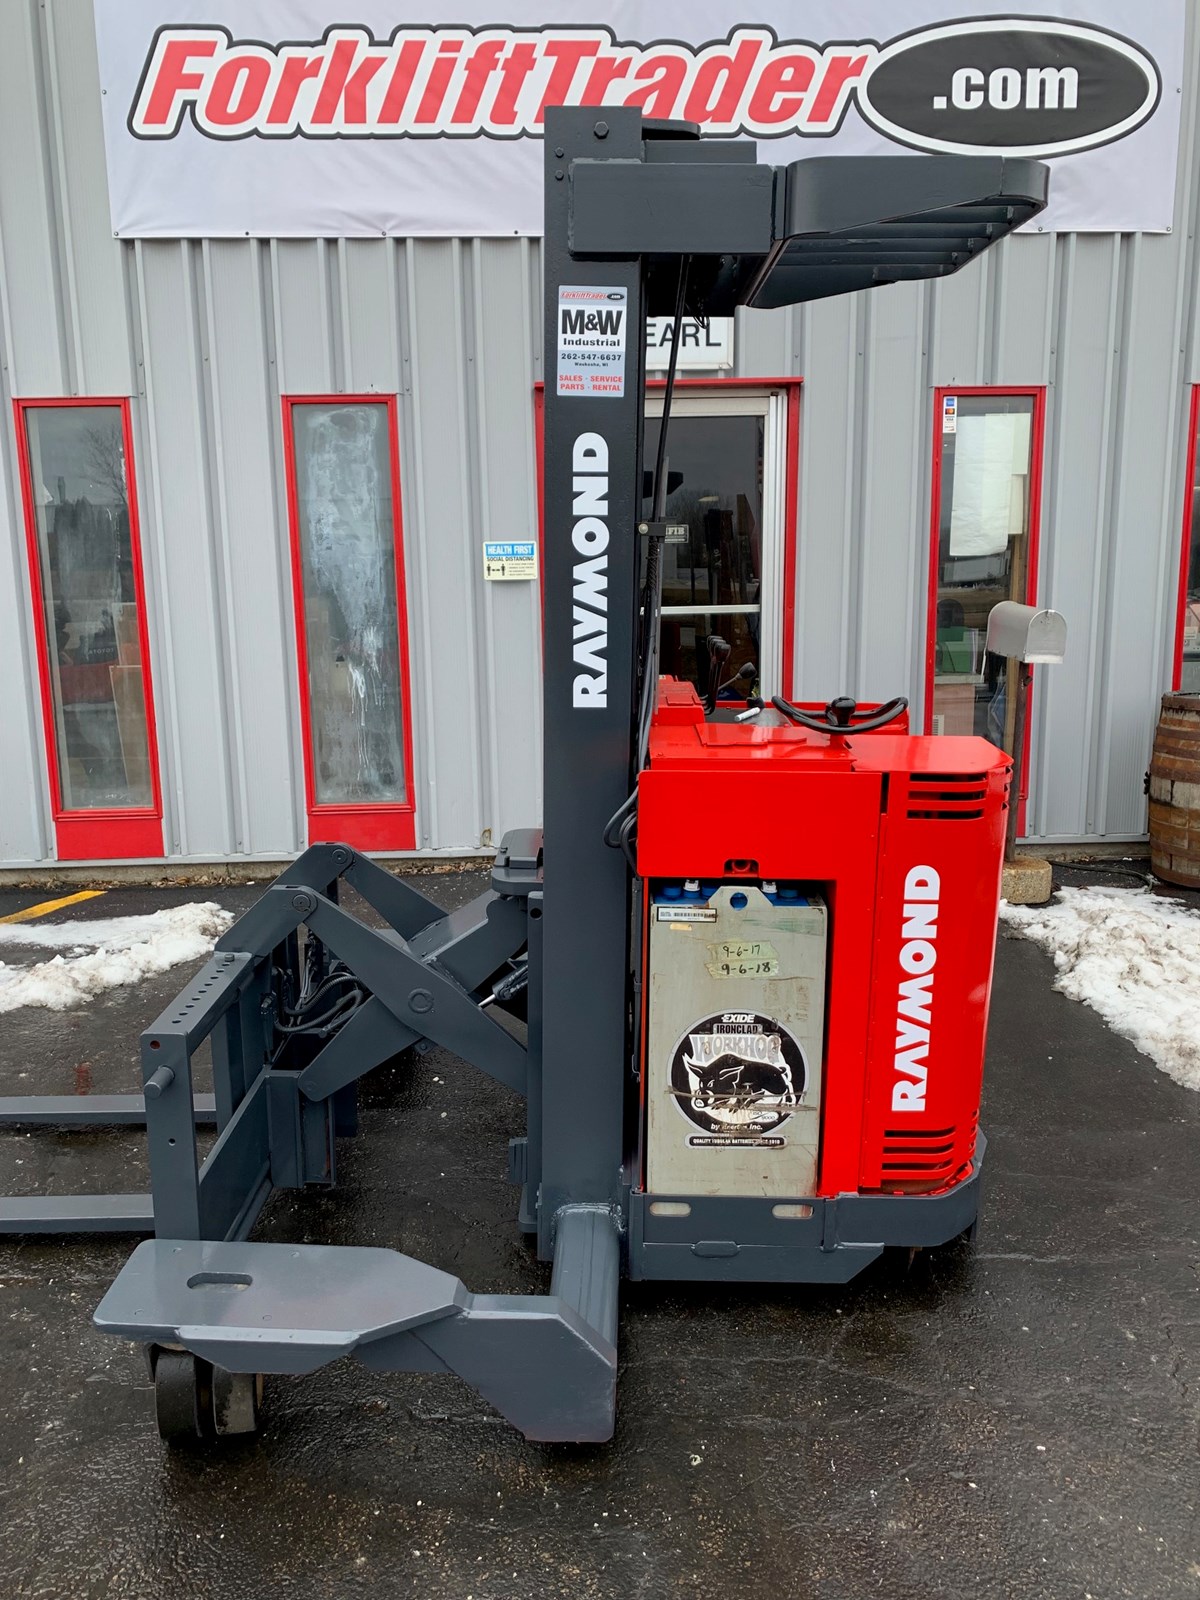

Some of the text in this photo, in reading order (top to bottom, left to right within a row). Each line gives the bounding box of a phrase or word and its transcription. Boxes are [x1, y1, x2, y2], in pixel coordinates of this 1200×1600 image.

[933, 66, 1079, 110] .com
[561, 309, 623, 335] M&W
[563, 337, 621, 347] Industrial
[561, 353, 622, 361] 262-547-6637
[559, 374, 623, 383] SALES SERVICE
[487, 545, 533, 555] HEALTH FIRST
[571, 432, 610, 708] RAYMOND
[722, 944, 761, 958] 9-6-17
[721, 961, 771, 975] 9-6-18
[891, 864, 941, 1112] RAYMOND
[721, 1014, 756, 1023] EXIDE
[716, 1024, 758, 1034] IRONCLAD
[710, 1122, 720, 1131] by
